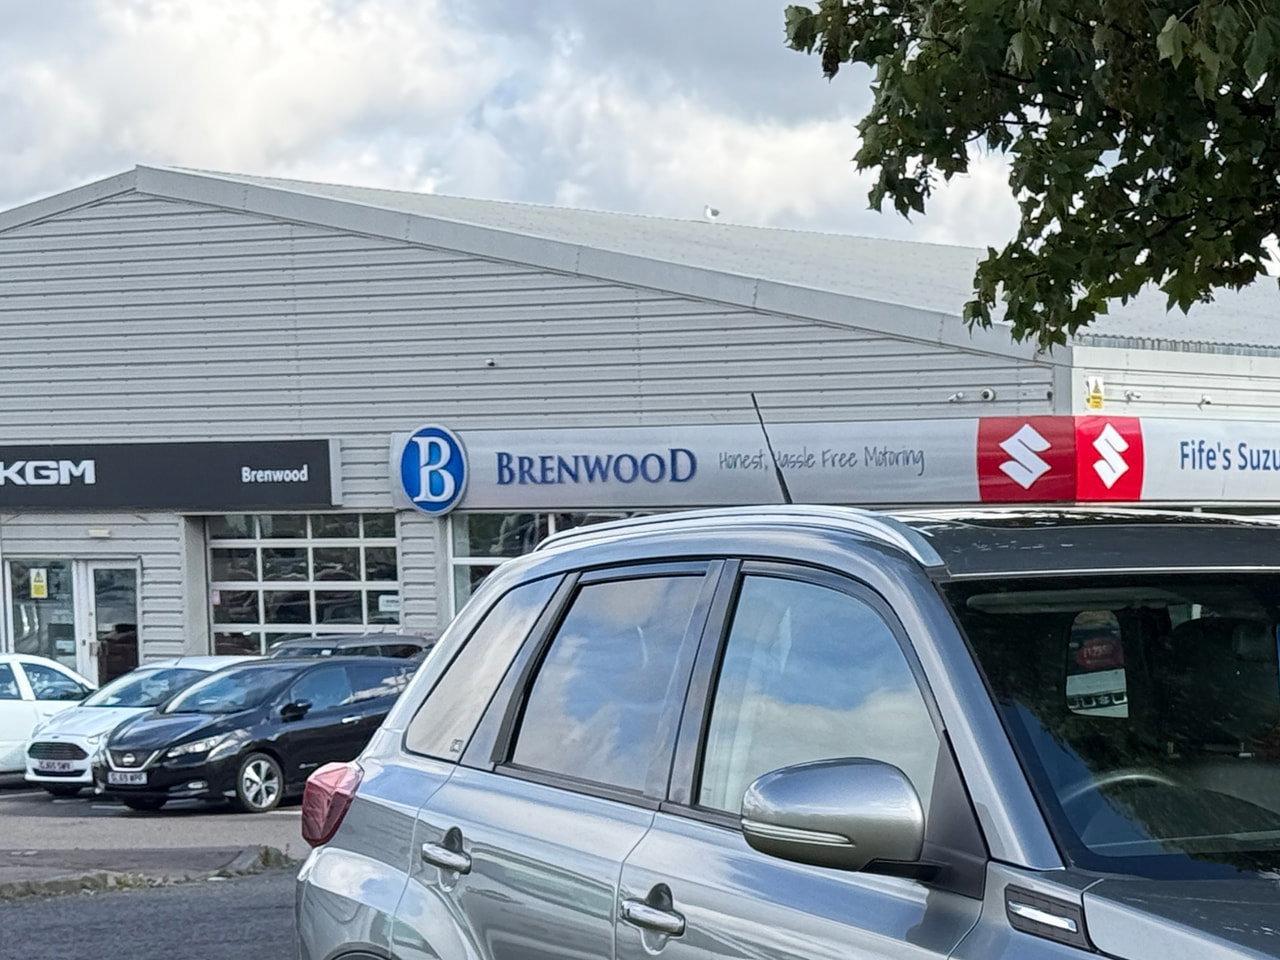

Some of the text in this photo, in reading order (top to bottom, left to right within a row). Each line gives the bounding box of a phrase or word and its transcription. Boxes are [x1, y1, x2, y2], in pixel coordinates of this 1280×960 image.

[411, 436, 455, 503] B
[496, 448, 698, 485] BRENWOOD
[719, 448, 768, 471] Honest,
[822, 448, 858, 468] Free
[864, 446, 925, 476] Motoring
[1180, 440, 1232, 470] Fife's
[0, 459, 96, 485] KGM
[241, 464, 309, 483] Brenwood
